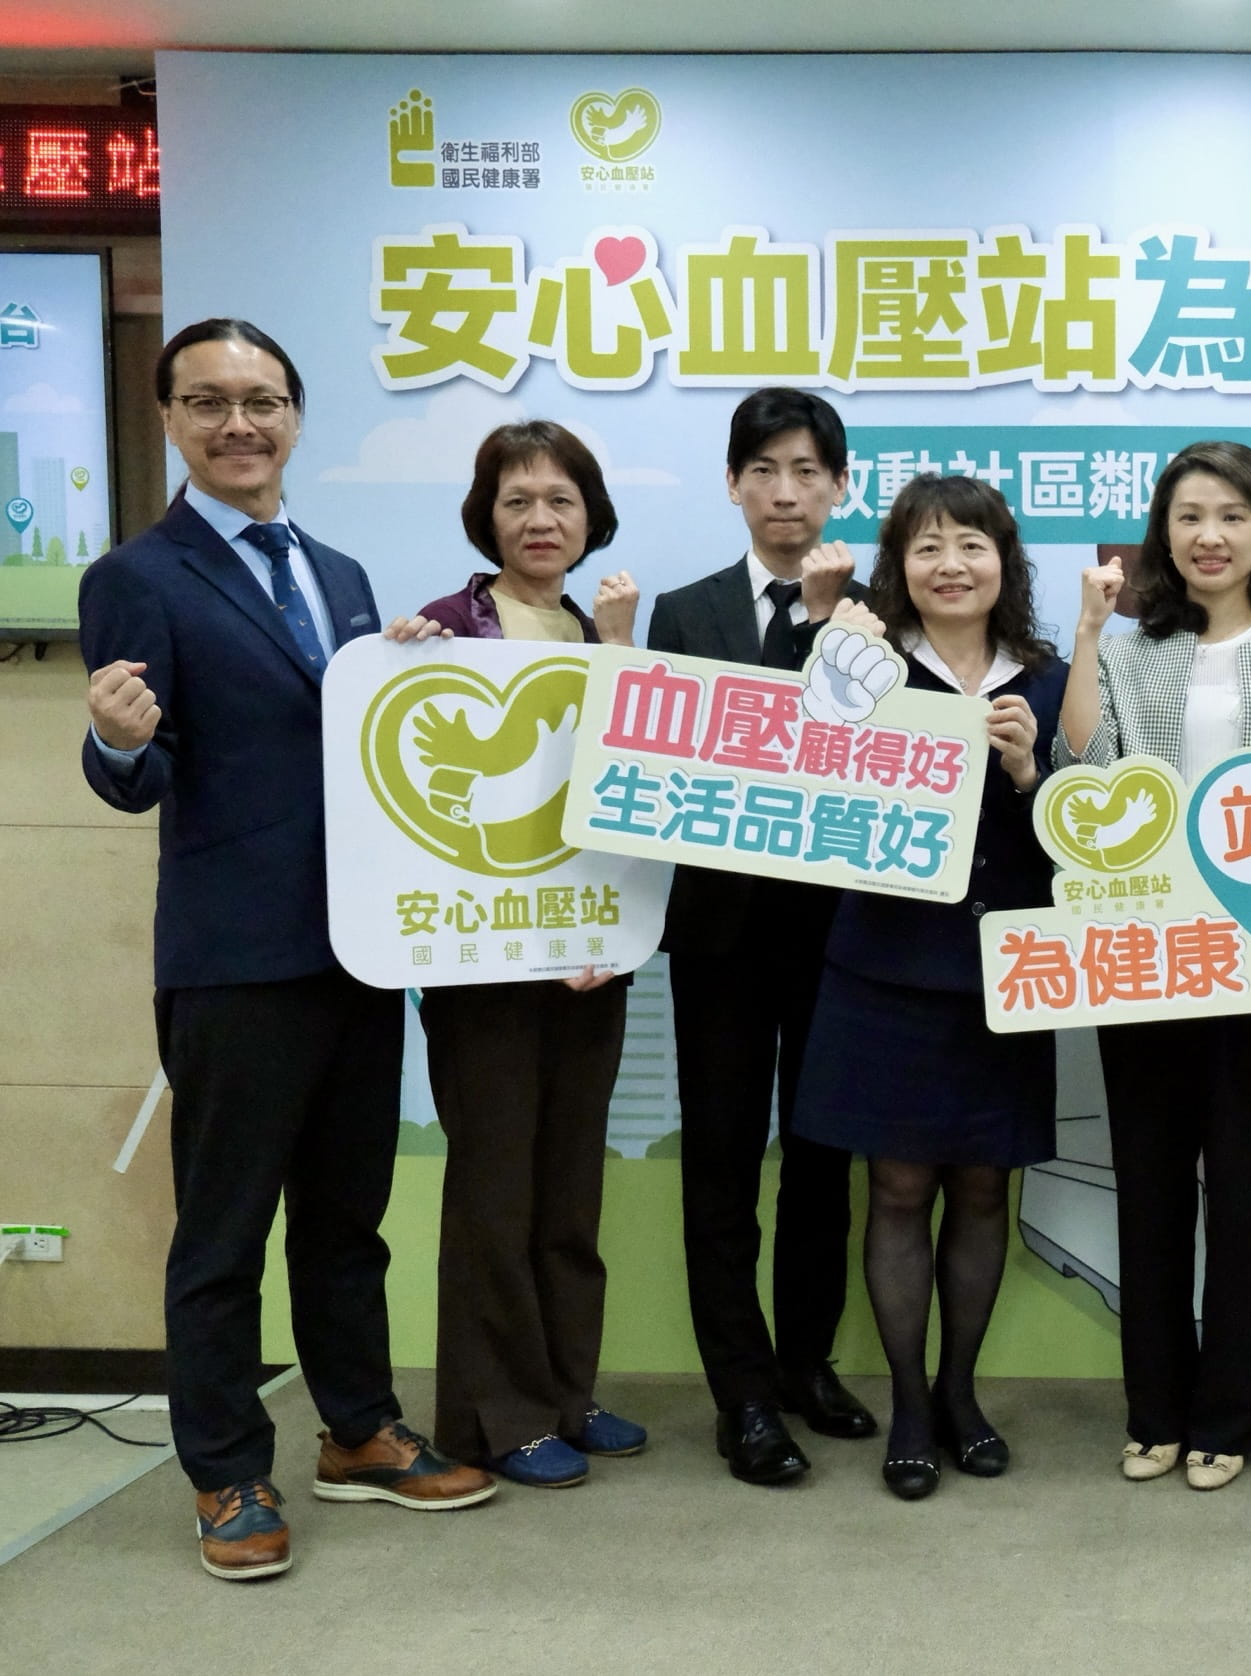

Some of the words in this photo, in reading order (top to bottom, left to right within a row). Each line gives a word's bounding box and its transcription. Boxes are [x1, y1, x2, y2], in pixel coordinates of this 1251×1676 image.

[0, 128, 160, 197] 壓站
[440, 141, 541, 164] 衛生福利部
[580, 166, 655, 181] 安心血壓站
[441, 167, 541, 189] 國民健康署
[0, 302, 38, 345] 台
[603, 663, 964, 794] 血壓顧得好
[589, 763, 951, 879] 生活品質好
[1064, 873, 1172, 902] 安心血壓站
[396, 884, 621, 936] 安心血壓站
[412, 937, 606, 966] 國民健康署
[998, 917, 1244, 1012] 為健康
